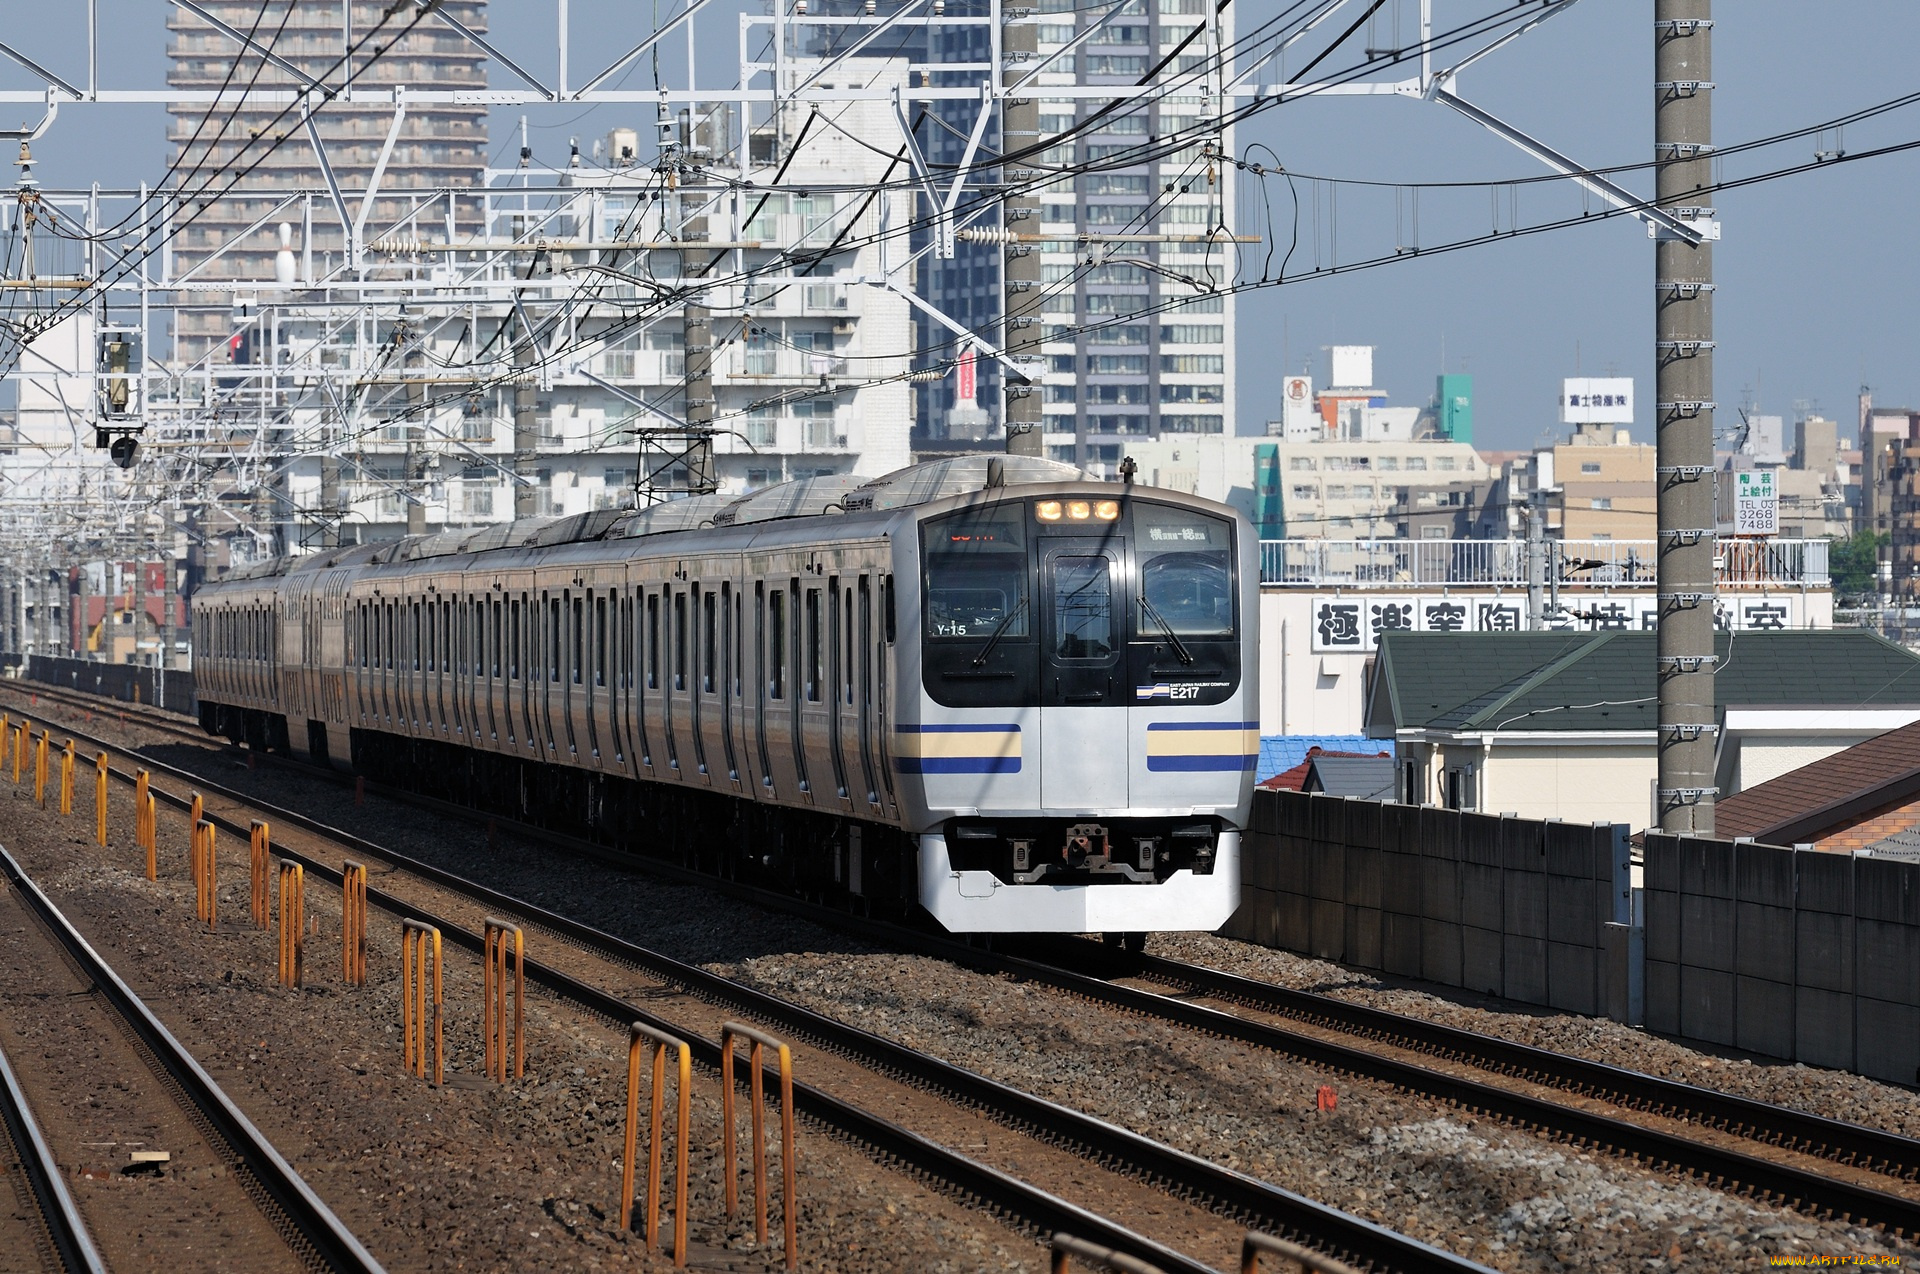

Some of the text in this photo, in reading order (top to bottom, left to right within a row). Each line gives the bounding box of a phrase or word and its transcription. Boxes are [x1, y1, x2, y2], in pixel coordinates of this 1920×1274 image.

[240, 303, 247, 317] 1
[1740, 486, 1772, 497] 上絵付
[1740, 500, 1774, 509] TEL 03
[1740, 509, 1773, 519] 3268
[1740, 520, 1773, 529] 7488
[937, 624, 967, 636] Y-15
[1170, 687, 1200, 699] E217
